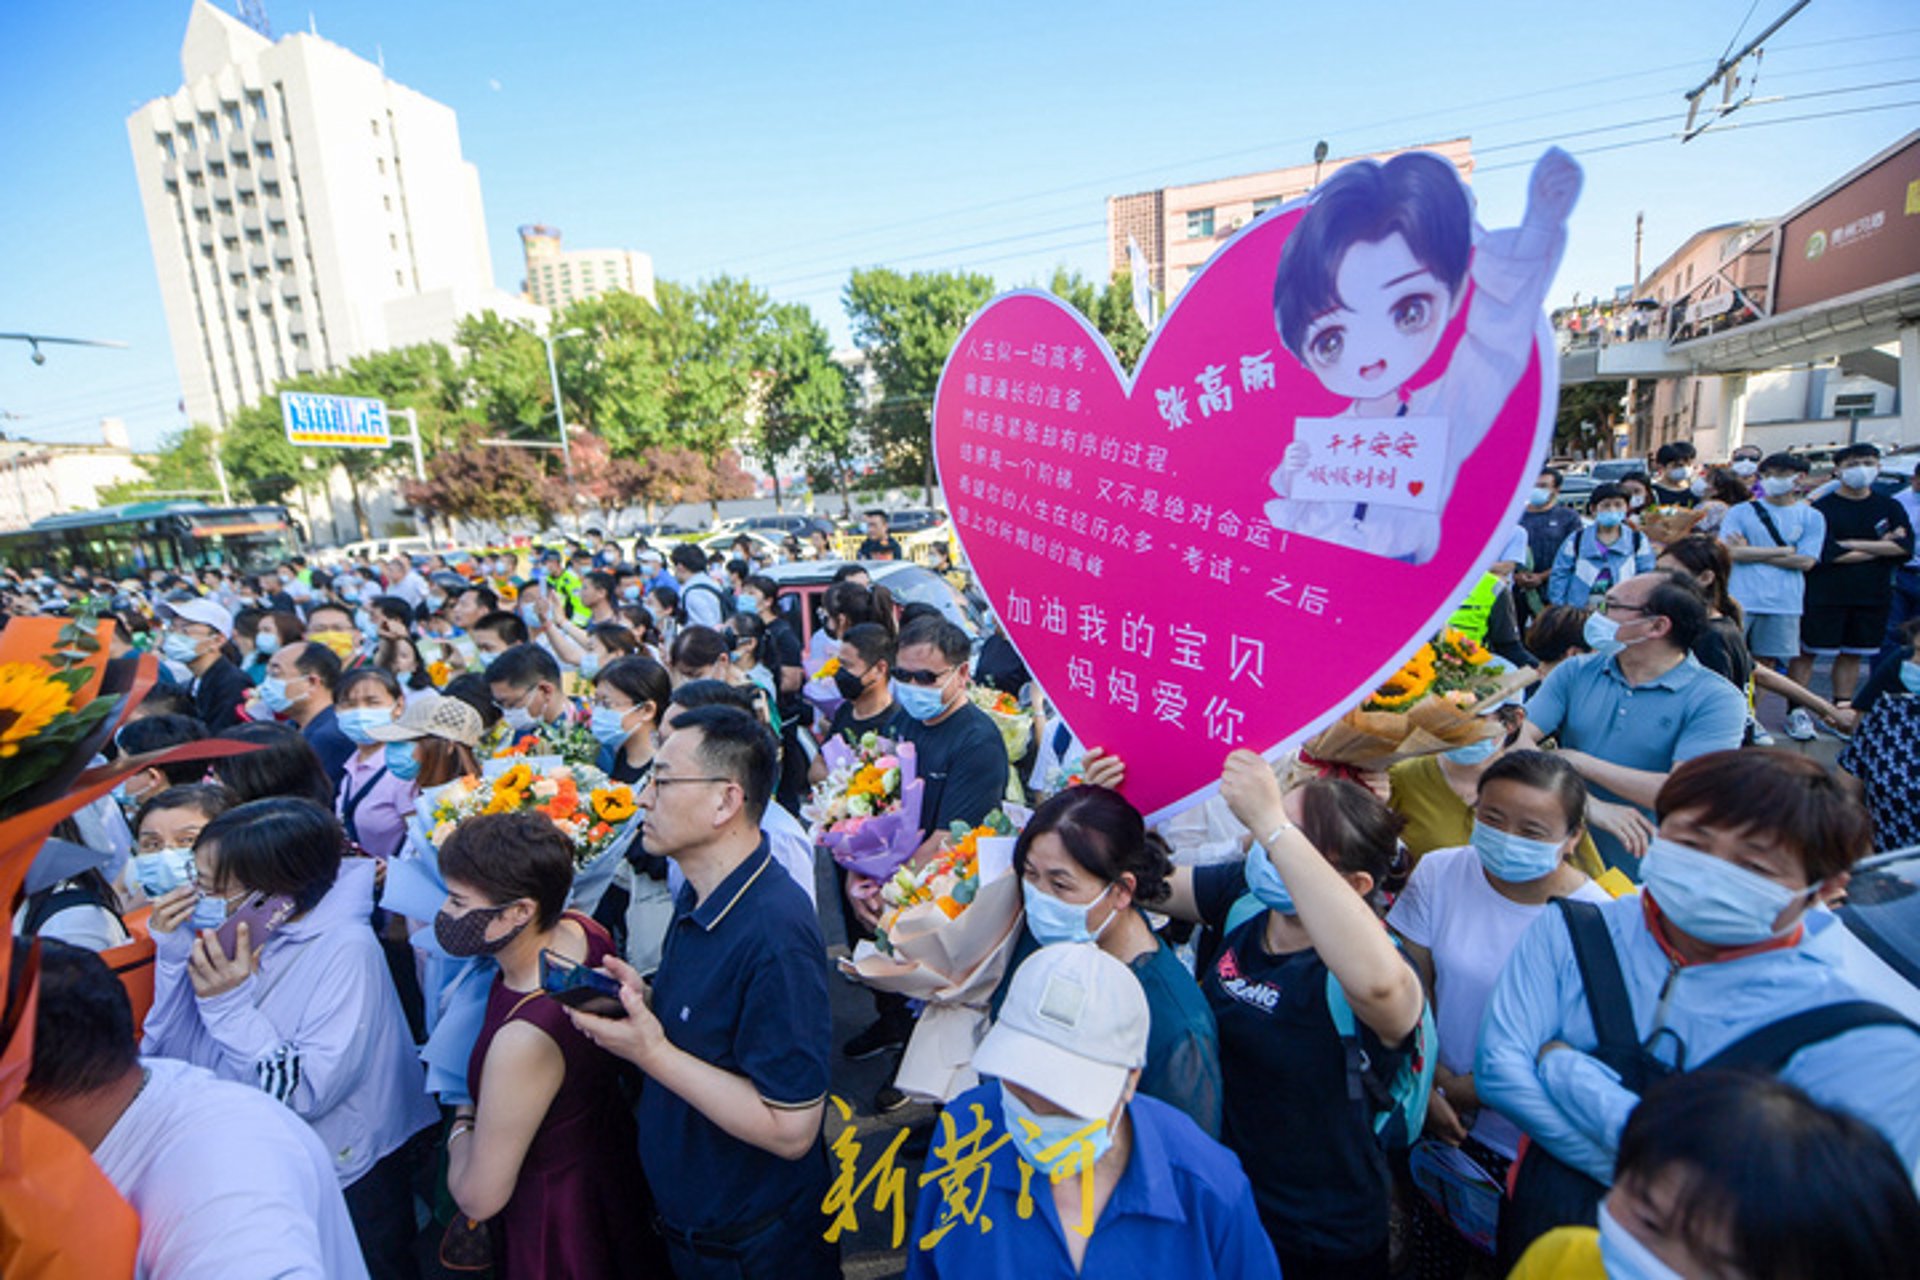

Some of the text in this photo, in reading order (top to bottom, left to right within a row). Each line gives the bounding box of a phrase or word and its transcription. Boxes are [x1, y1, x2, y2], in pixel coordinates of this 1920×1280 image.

[1007, 588, 1265, 689] 加油我的宝贝
[1067, 655, 1245, 745] 妈妈爱你
